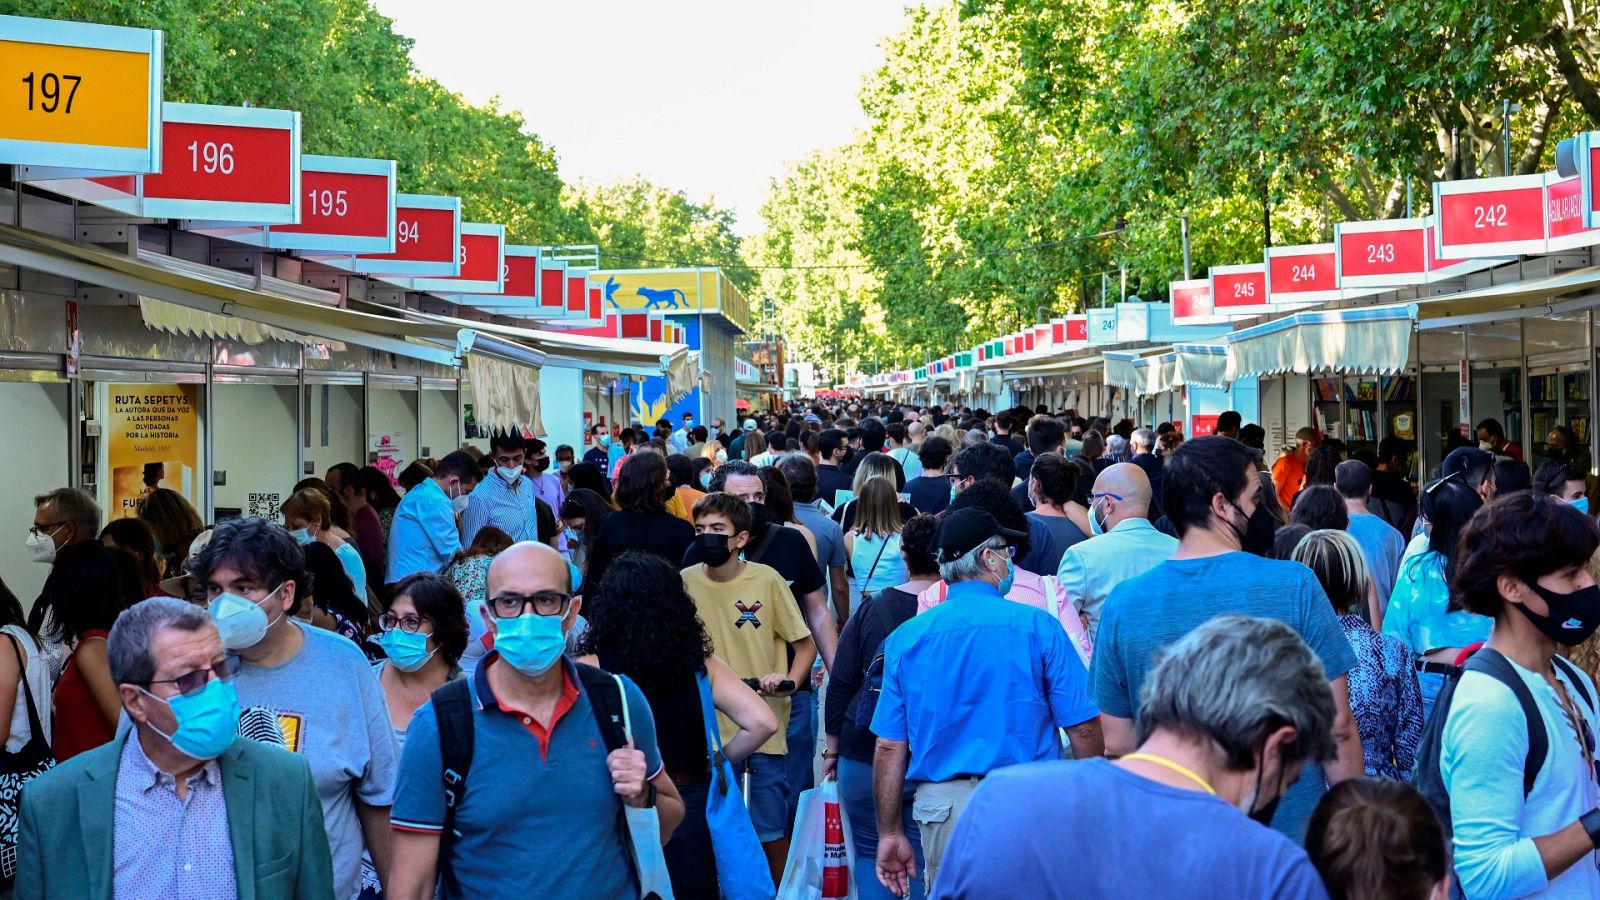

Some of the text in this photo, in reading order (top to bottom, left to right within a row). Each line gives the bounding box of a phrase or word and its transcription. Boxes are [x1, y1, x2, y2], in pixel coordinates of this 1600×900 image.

[22, 72, 82, 114] 197
[187, 141, 234, 175] 196
[308, 189, 348, 217] 195
[1474, 205, 1508, 228] 242
[398, 220, 420, 243] 94
[1367, 244, 1395, 263] 243
[1292, 264, 1316, 282] 244
[1234, 282, 1255, 297] 245
[1102, 320, 1115, 331] 247
[115, 395, 141, 404] RUTA
[123, 499, 142, 507] FUE
